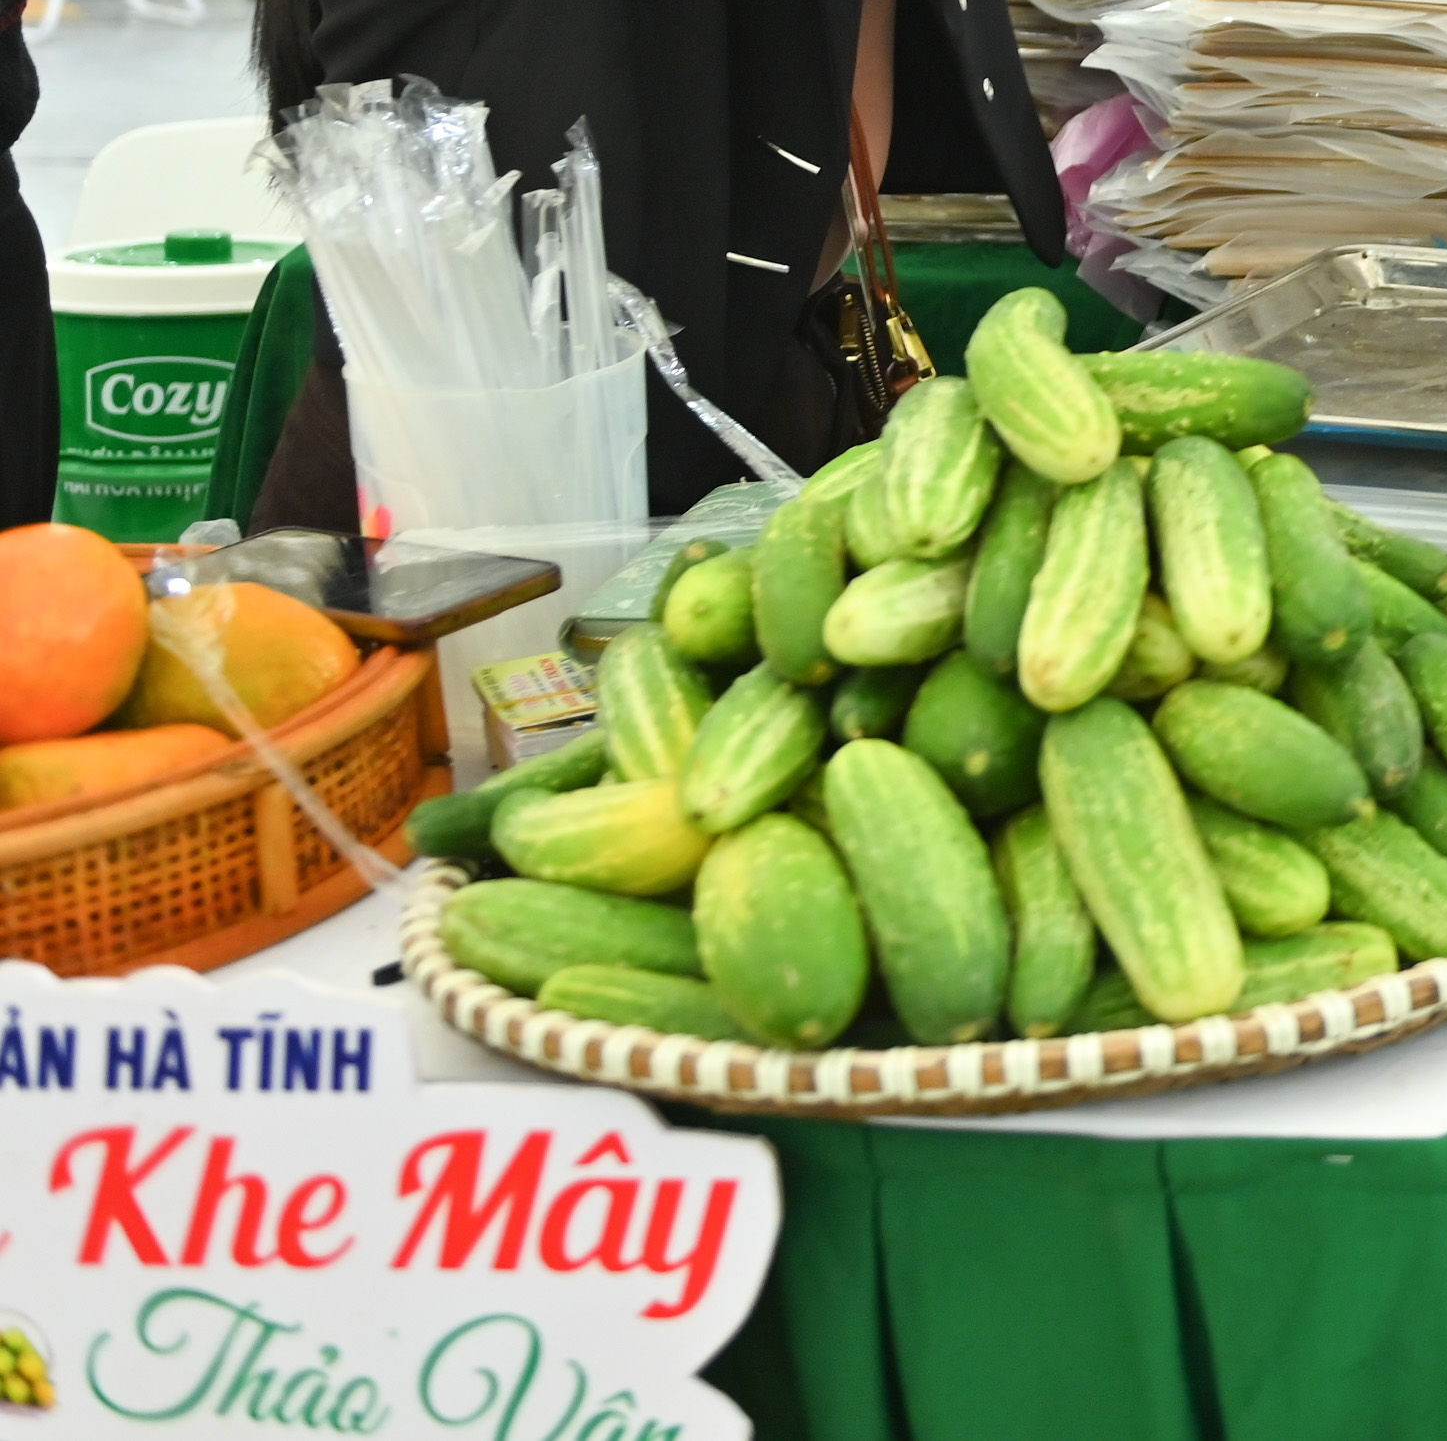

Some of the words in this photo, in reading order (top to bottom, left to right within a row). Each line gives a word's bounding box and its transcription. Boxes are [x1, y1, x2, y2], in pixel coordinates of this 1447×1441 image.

[101, 372, 228, 427] Cozy
[105, 1008, 191, 1091] HÀ
[216, 1011, 373, 1092] TĨNH
[49, 1125, 356, 1269] Khe
[390, 1128, 742, 1321] Mây
[86, 1287, 389, 1435] Thảo
